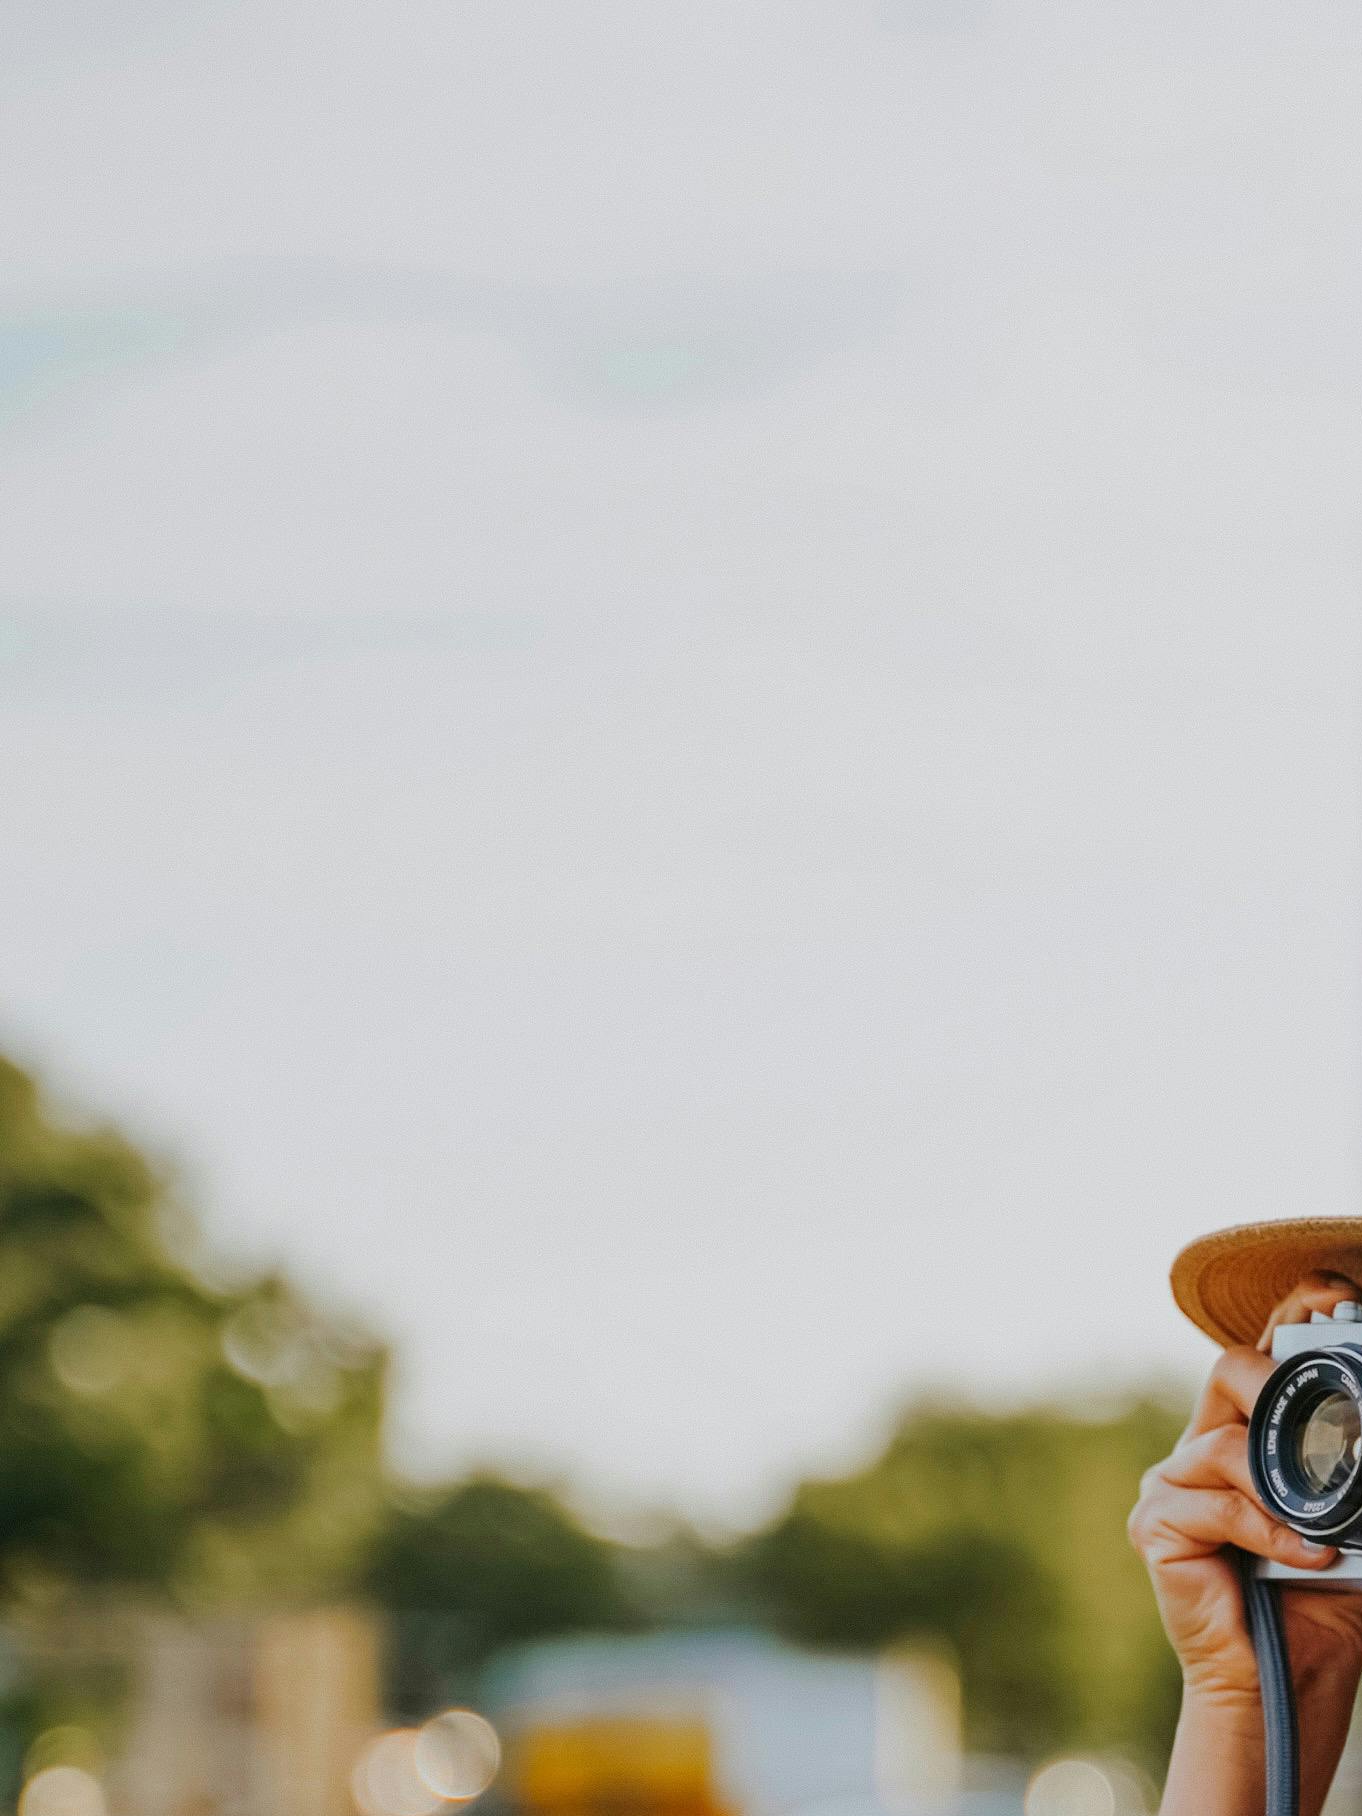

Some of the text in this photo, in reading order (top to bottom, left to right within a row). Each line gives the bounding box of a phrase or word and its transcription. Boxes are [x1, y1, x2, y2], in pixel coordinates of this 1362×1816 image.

[1271, 1396, 1289, 1425] MADE
[1285, 1384, 1297, 1397] IN
[1296, 1368, 1320, 1387] JAPAN
